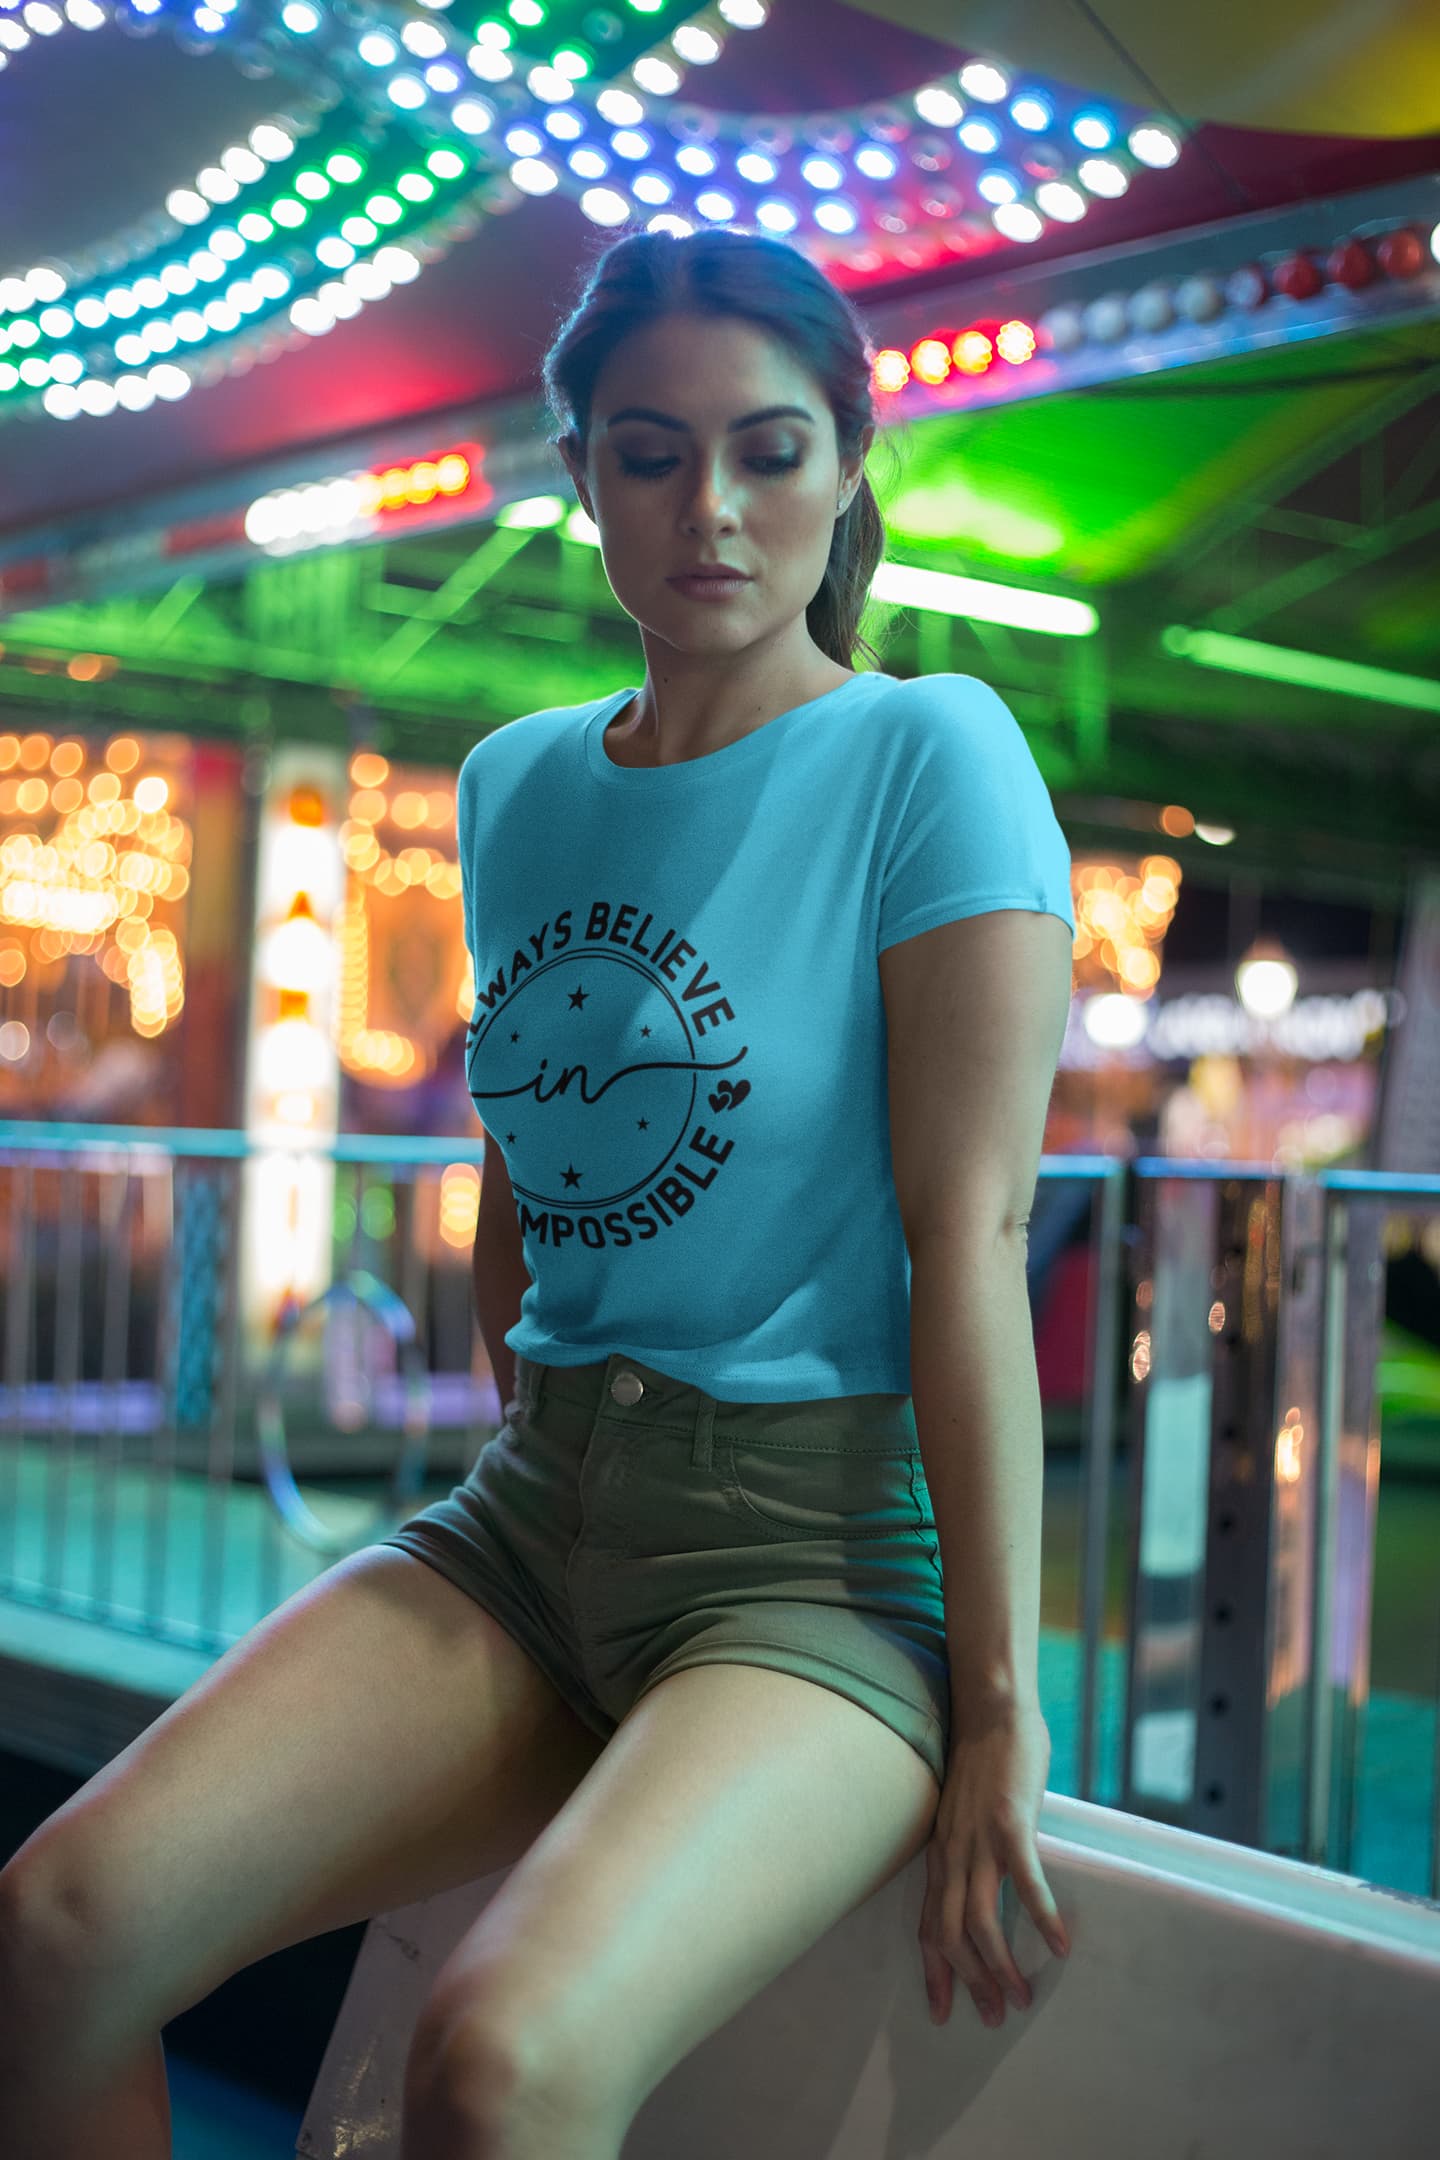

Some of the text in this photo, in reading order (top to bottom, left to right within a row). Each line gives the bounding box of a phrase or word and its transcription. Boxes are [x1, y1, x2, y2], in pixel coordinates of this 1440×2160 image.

[466, 902, 736, 1050] LWAYS BELIEVE
[516, 1126, 736, 1249] MPOSSIBLE
